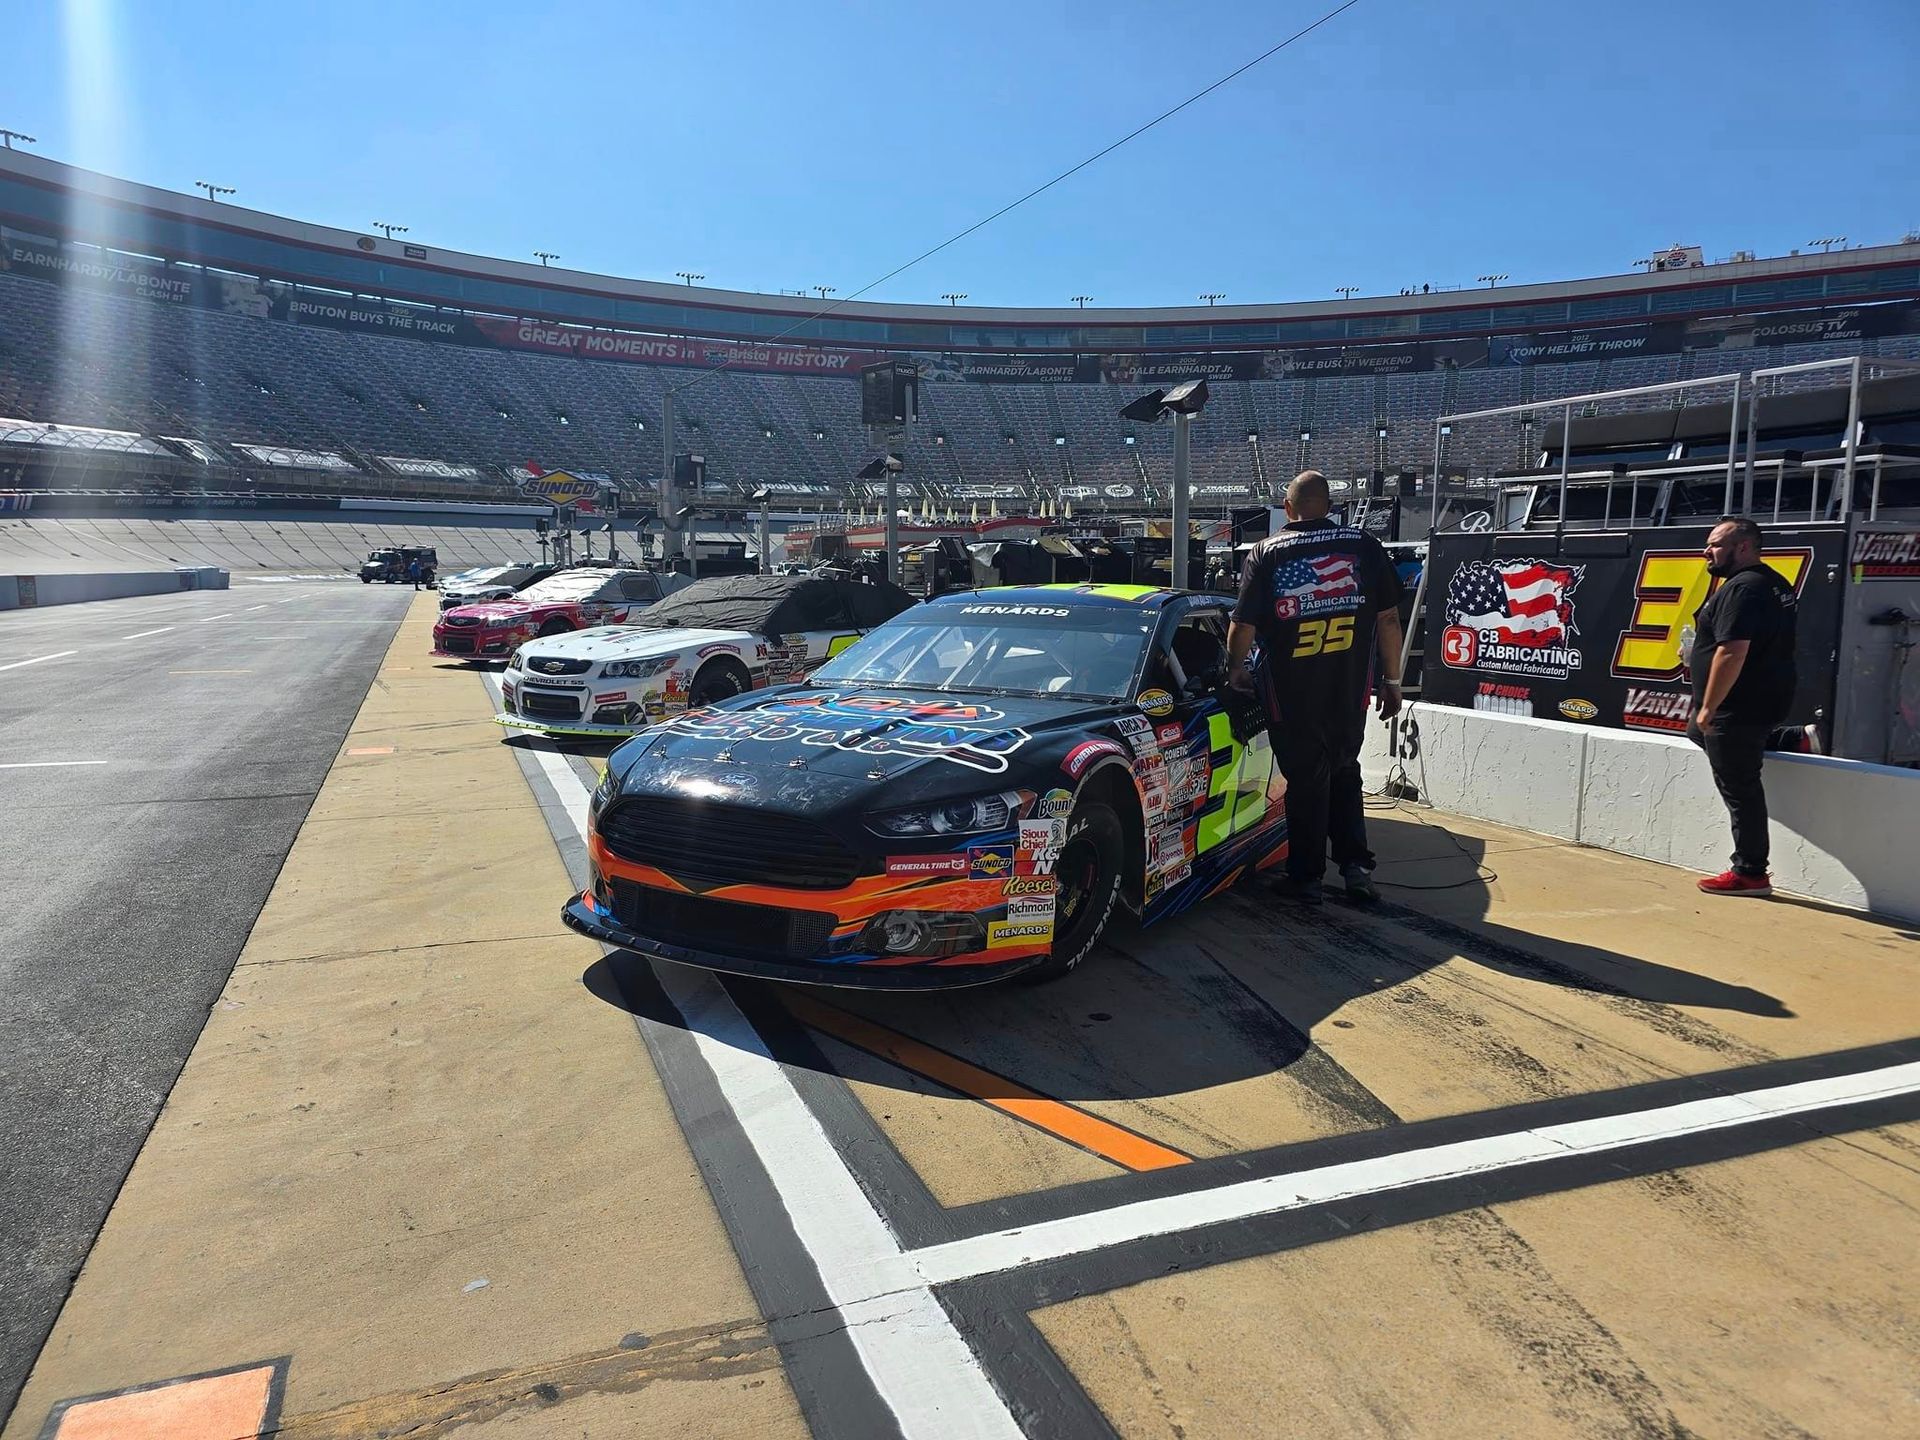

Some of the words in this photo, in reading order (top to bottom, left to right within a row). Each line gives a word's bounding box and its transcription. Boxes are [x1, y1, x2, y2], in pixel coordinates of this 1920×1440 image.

[12, 249, 191, 293] EARNHARDT/LABONTE
[136, 287, 170, 300] CLASH
[173, 294, 183, 302] #1
[290, 301, 347, 319] BRUTON
[350, 311, 384, 325] BUYS
[388, 315, 412, 329] THE
[415, 320, 455, 334] TRACK
[1752, 322, 1824, 337] COLOSSUS
[1827, 320, 1847, 331] TV
[1822, 330, 1862, 339] DEBUTS
[518, 325, 582, 348] GREAT
[586, 336, 677, 358] MOMENTS
[1513, 344, 1546, 357] TONY
[1547, 341, 1597, 355] HELMET
[1598, 337, 1646, 351] THROW
[729, 347, 770, 361] Bristol
[776, 351, 850, 369] HISTORY
[1129, 367, 1155, 376] DALE
[1158, 364, 1220, 375] EARNHARDT
[1291, 360, 1314, 370] KYLE
[1358, 355, 1413, 366] WEEKEND
[1373, 365, 1400, 373] SWEEP
[962, 365, 1075, 377] EARNHARDT/LABONTE
[525, 480, 598, 497] SUNOCO
[1356, 478, 1367, 489] 27
[1299, 592, 1315, 602] CB
[1300, 595, 1366, 610] FABRICATING
[959, 606, 1070, 617] MENARDS
[1292, 616, 1355, 658] 35
[1478, 629, 1499, 643] CB
[1478, 644, 1580, 667] FABRICATING
[1476, 660, 1501, 670] Custom
[1502, 662, 1523, 672] Metal
[1523, 664, 1566, 677] Fabricators
[523, 675, 567, 685] CHEVROLET
[1477, 682, 1495, 694] TOP
[1495, 684, 1531, 699] CHOICE
[1648, 691, 1678, 699] GREG
[1138, 694, 1174, 711] MENARDS
[1624, 688, 1693, 721] VANA
[1118, 718, 1142, 734] ARCA
[1626, 716, 1688, 729] MOTORSP
[822, 733, 890, 749] AIR
[1385, 716, 1419, 760] 13
[1070, 743, 1102, 773] GENERAL
[1021, 829, 1049, 840] Sioux
[1021, 839, 1047, 850] Chief
[890, 863, 930, 871] GENERAL
[971, 858, 1012, 870] SUNOCO
[1008, 898, 1054, 914] Richmond
[993, 926, 1049, 938] MENARDS
